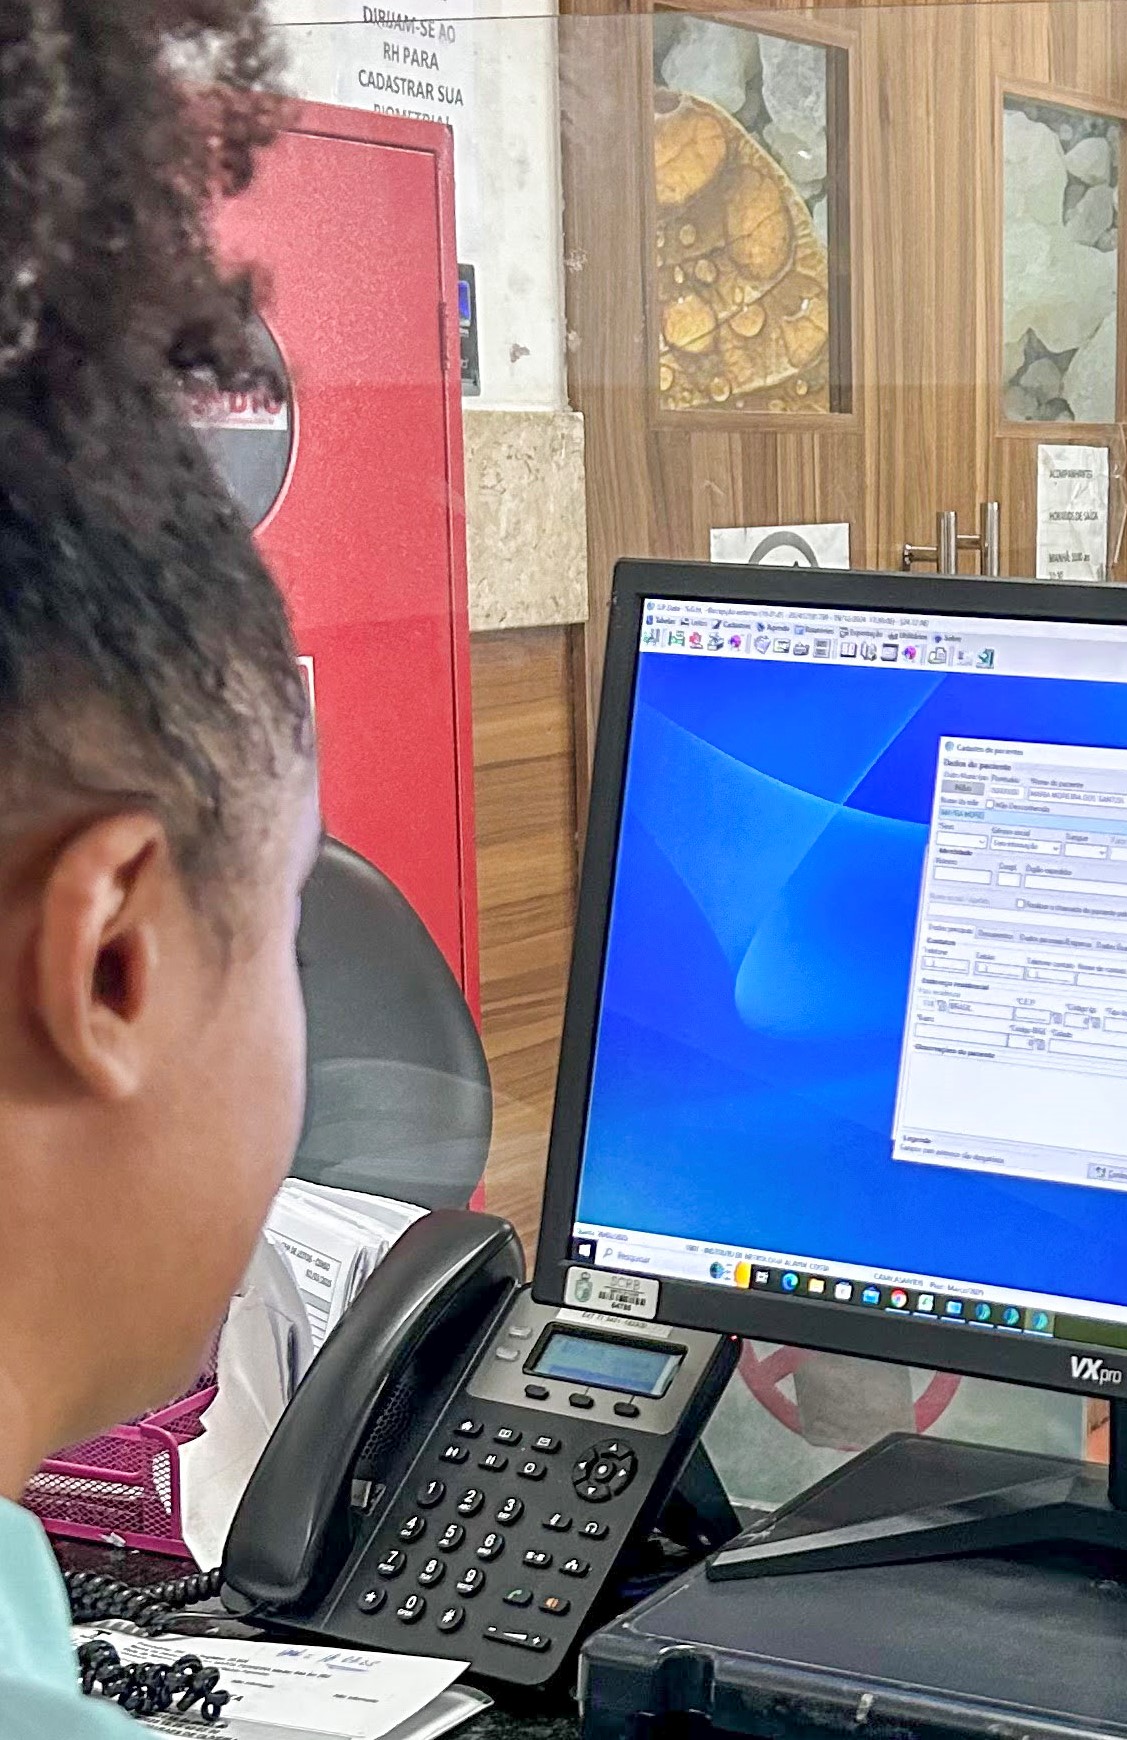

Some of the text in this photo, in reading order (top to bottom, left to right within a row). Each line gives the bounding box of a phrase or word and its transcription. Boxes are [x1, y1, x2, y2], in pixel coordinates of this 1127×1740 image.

[439, 23, 456, 43] AO
[383, 41, 440, 71] RH PARA
[358, 69, 464, 107] CADASTRAR SUA
[427, 1481, 437, 1494] 1
[464, 1489, 477, 1503] 2
[504, 1498, 516, 1511] 3
[406, 1516, 418, 1529] 4
[445, 1524, 458, 1538] 5
[484, 1533, 497, 1547] 6
[387, 1550, 399, 1563] 7
[425, 1559, 437, 1573] 8
[465, 1568, 477, 1583] 9
[405, 1595, 418, 1609] 0
